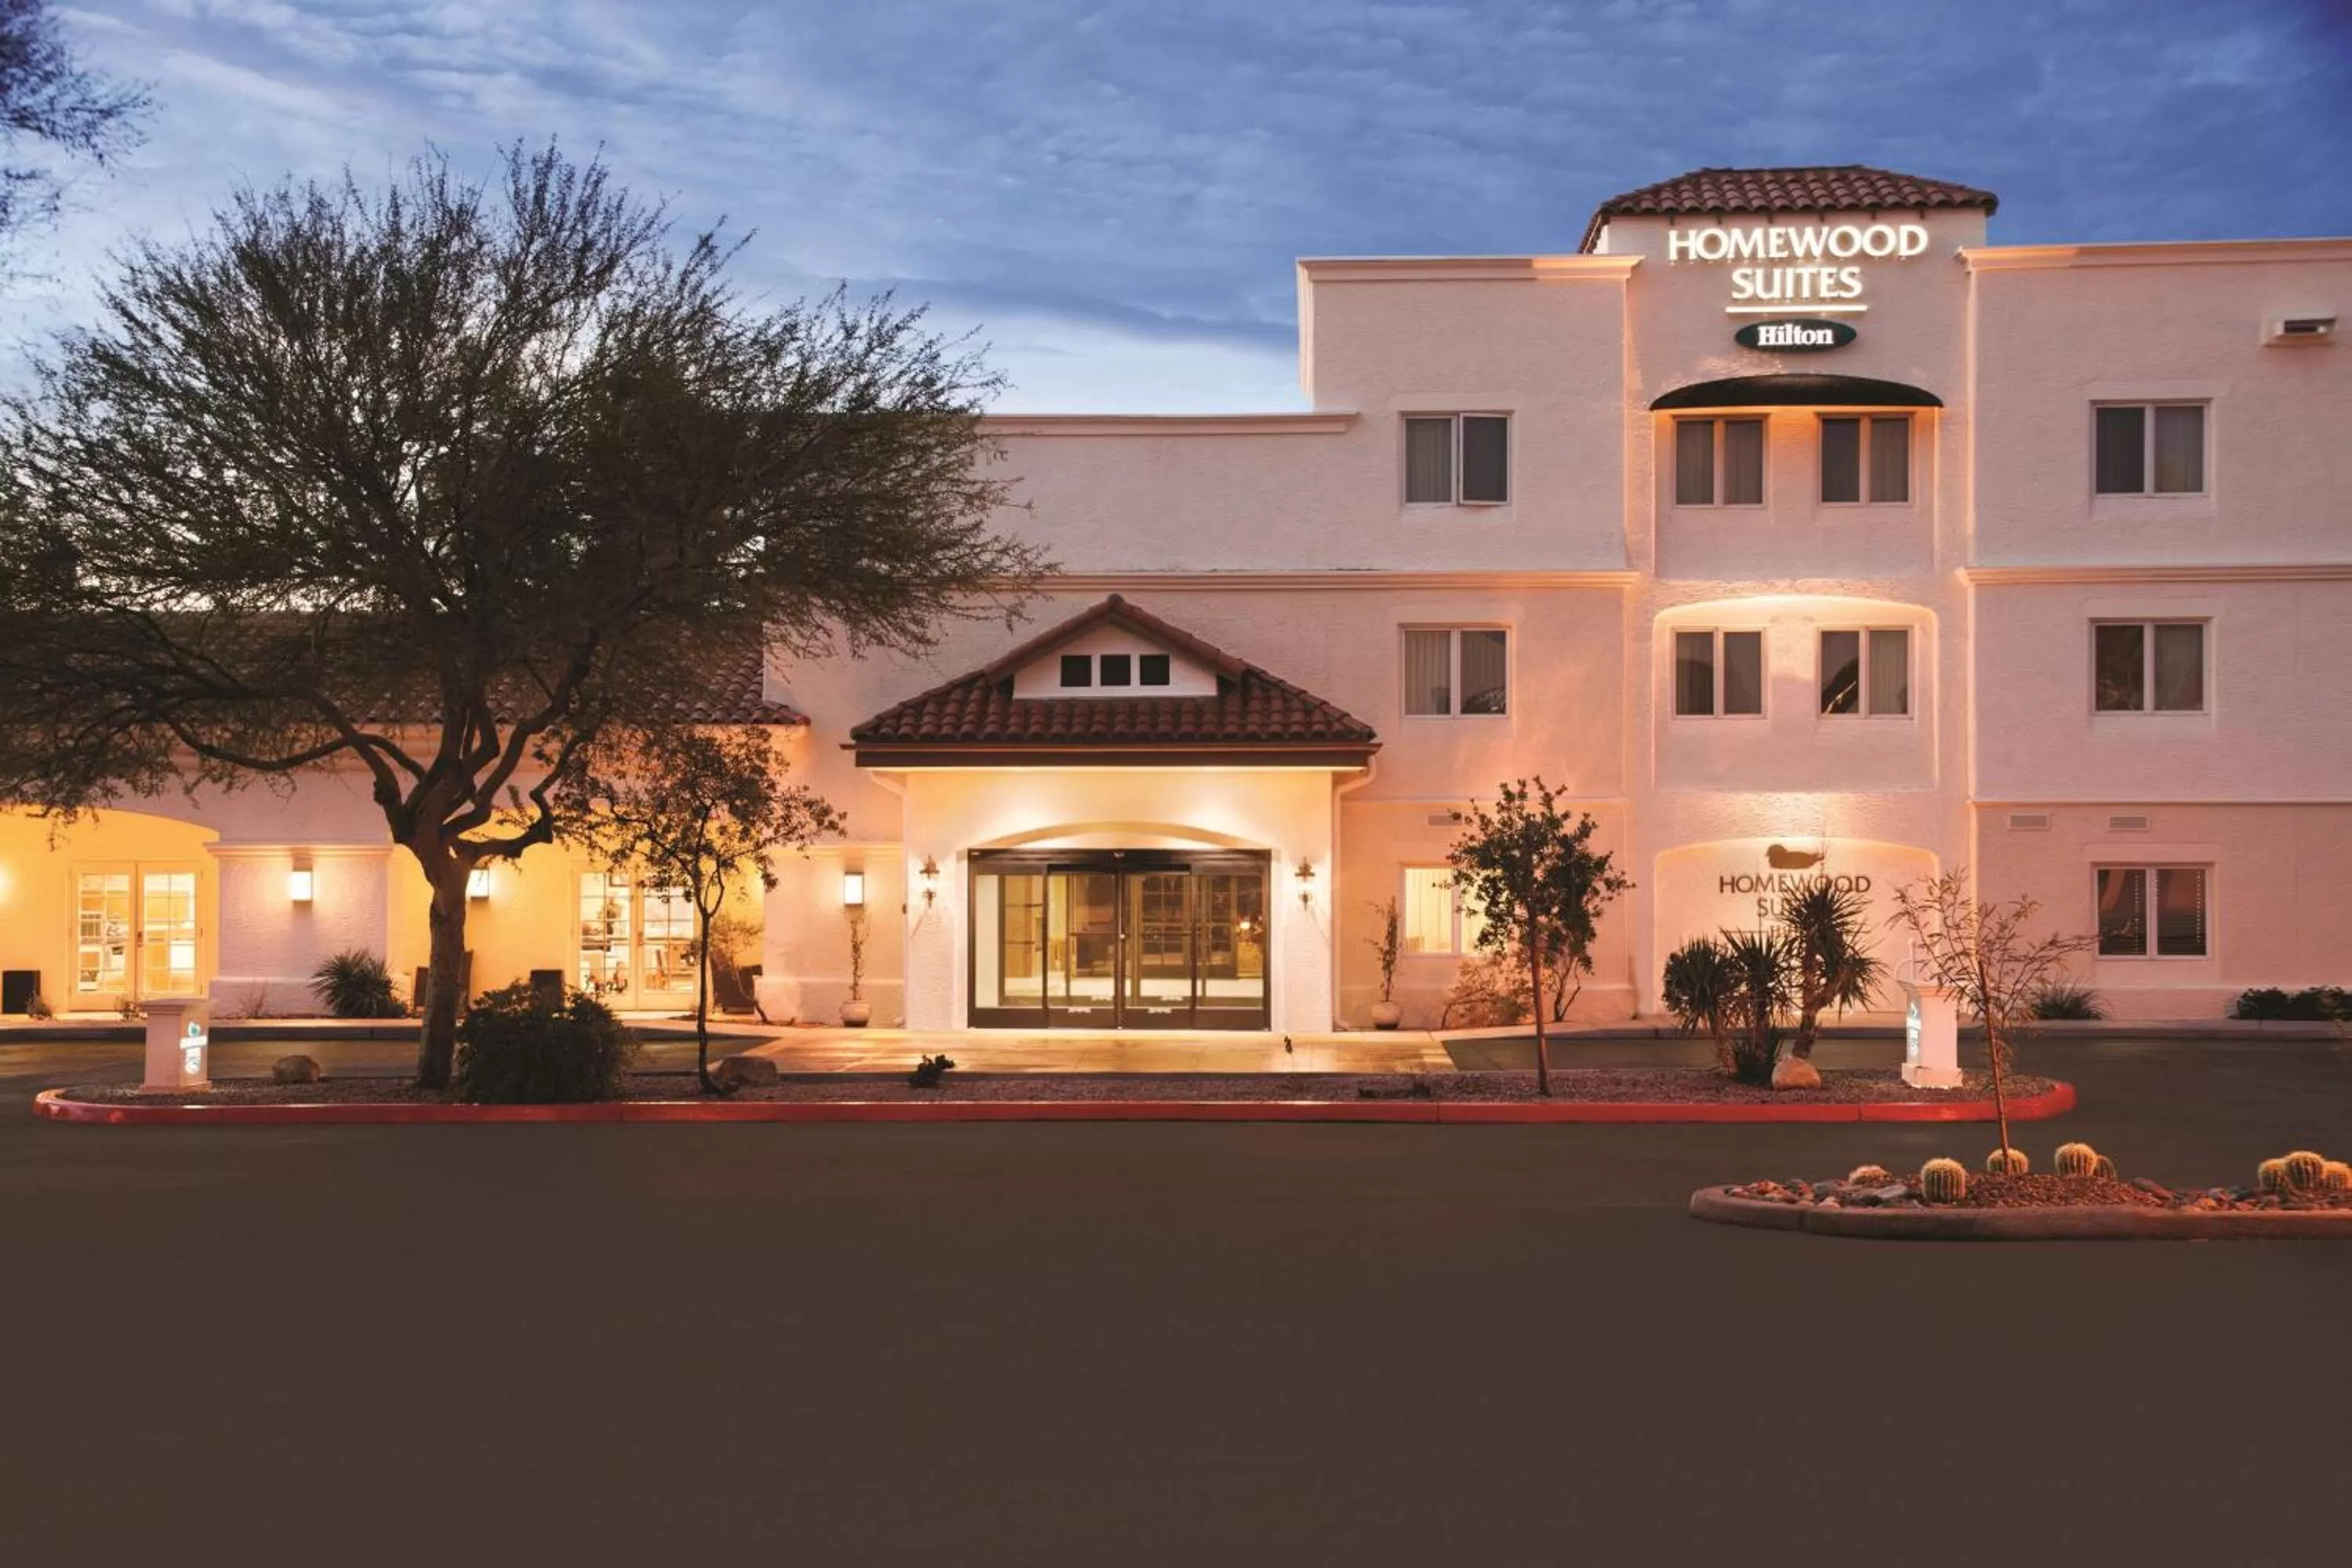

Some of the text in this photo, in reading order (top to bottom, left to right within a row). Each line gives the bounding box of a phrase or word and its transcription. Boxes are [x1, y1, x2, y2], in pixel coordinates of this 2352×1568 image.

[1668, 224, 1929, 260] HOMEWOOD
[1730, 266, 1864, 299] SUITES
[1756, 323, 1835, 346] Hilton
